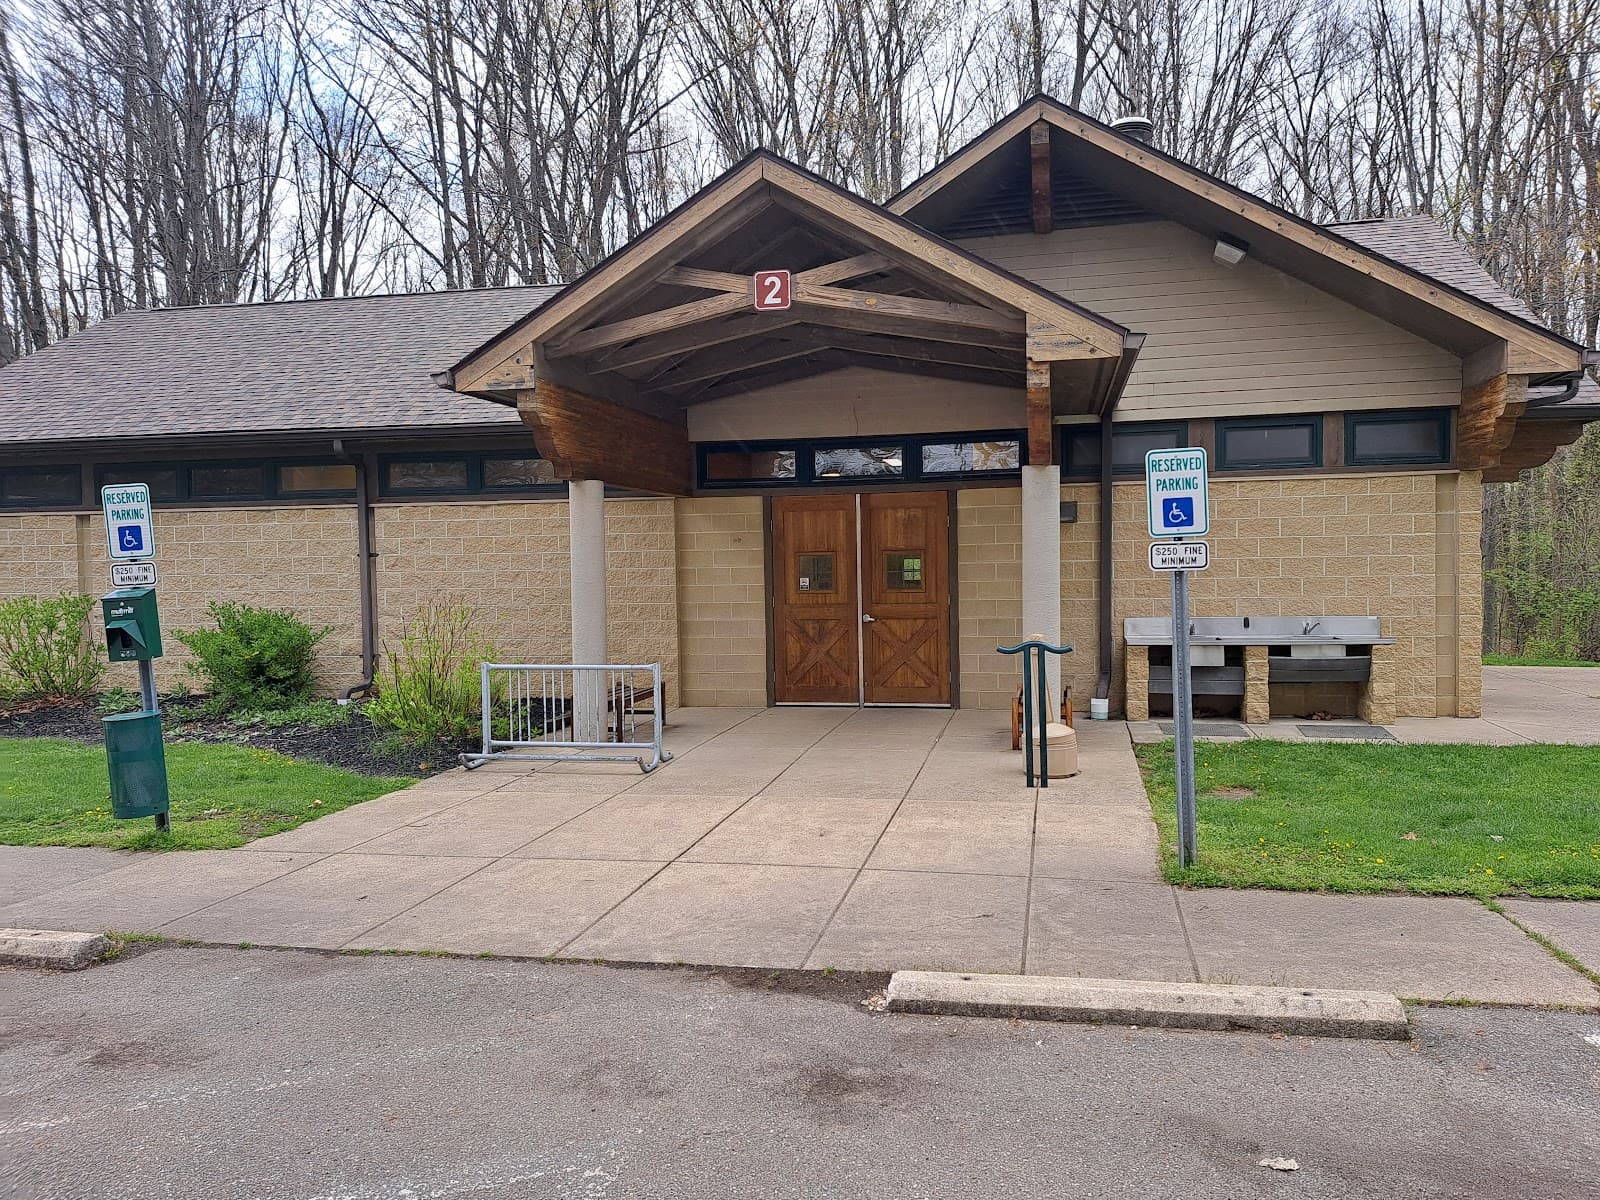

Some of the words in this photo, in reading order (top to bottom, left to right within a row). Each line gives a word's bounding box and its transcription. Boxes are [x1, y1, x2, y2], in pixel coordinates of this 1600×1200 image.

[764, 276, 782, 304] 2
[1151, 457, 1201, 472] RESERVED
[1156, 477, 1198, 492] PARKING
[106, 491, 146, 504] RESERVED
[112, 508, 144, 520] PARKING
[1155, 547, 1178, 556] $250
[1184, 546, 1203, 555] FINE
[1161, 556, 1197, 566] MINIMUM
[115, 566, 133, 575] $250
[137, 565, 152, 574] FINE
[120, 574, 149, 583] MINIMUM
